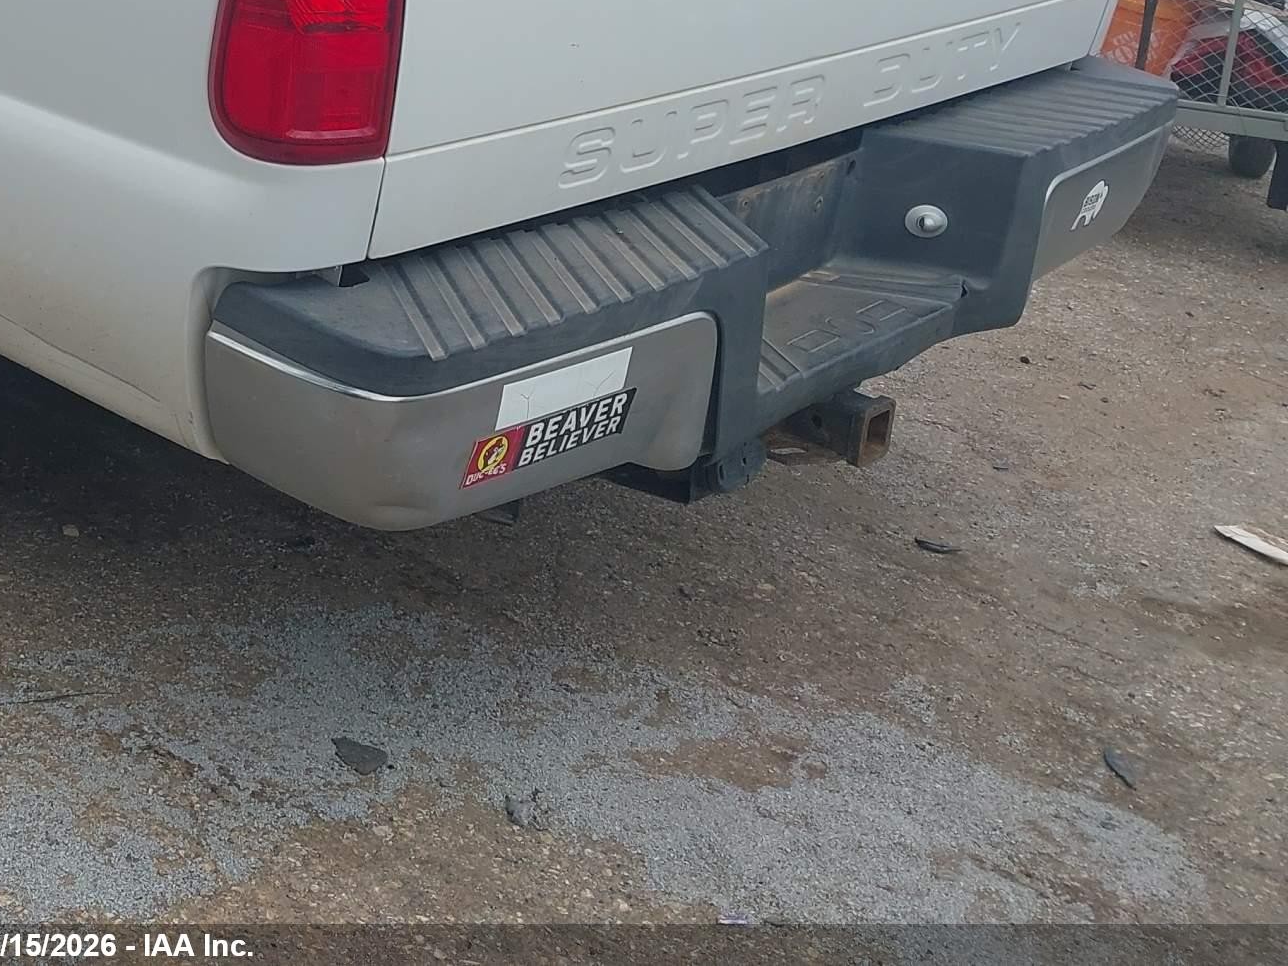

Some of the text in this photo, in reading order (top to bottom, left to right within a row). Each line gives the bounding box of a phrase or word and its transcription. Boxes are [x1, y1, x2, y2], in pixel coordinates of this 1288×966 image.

[558, 22, 1021, 189] SUPER DUTY
[518, 416, 621, 467] BELIEVER
[525, 393, 627, 447] BEAVER
